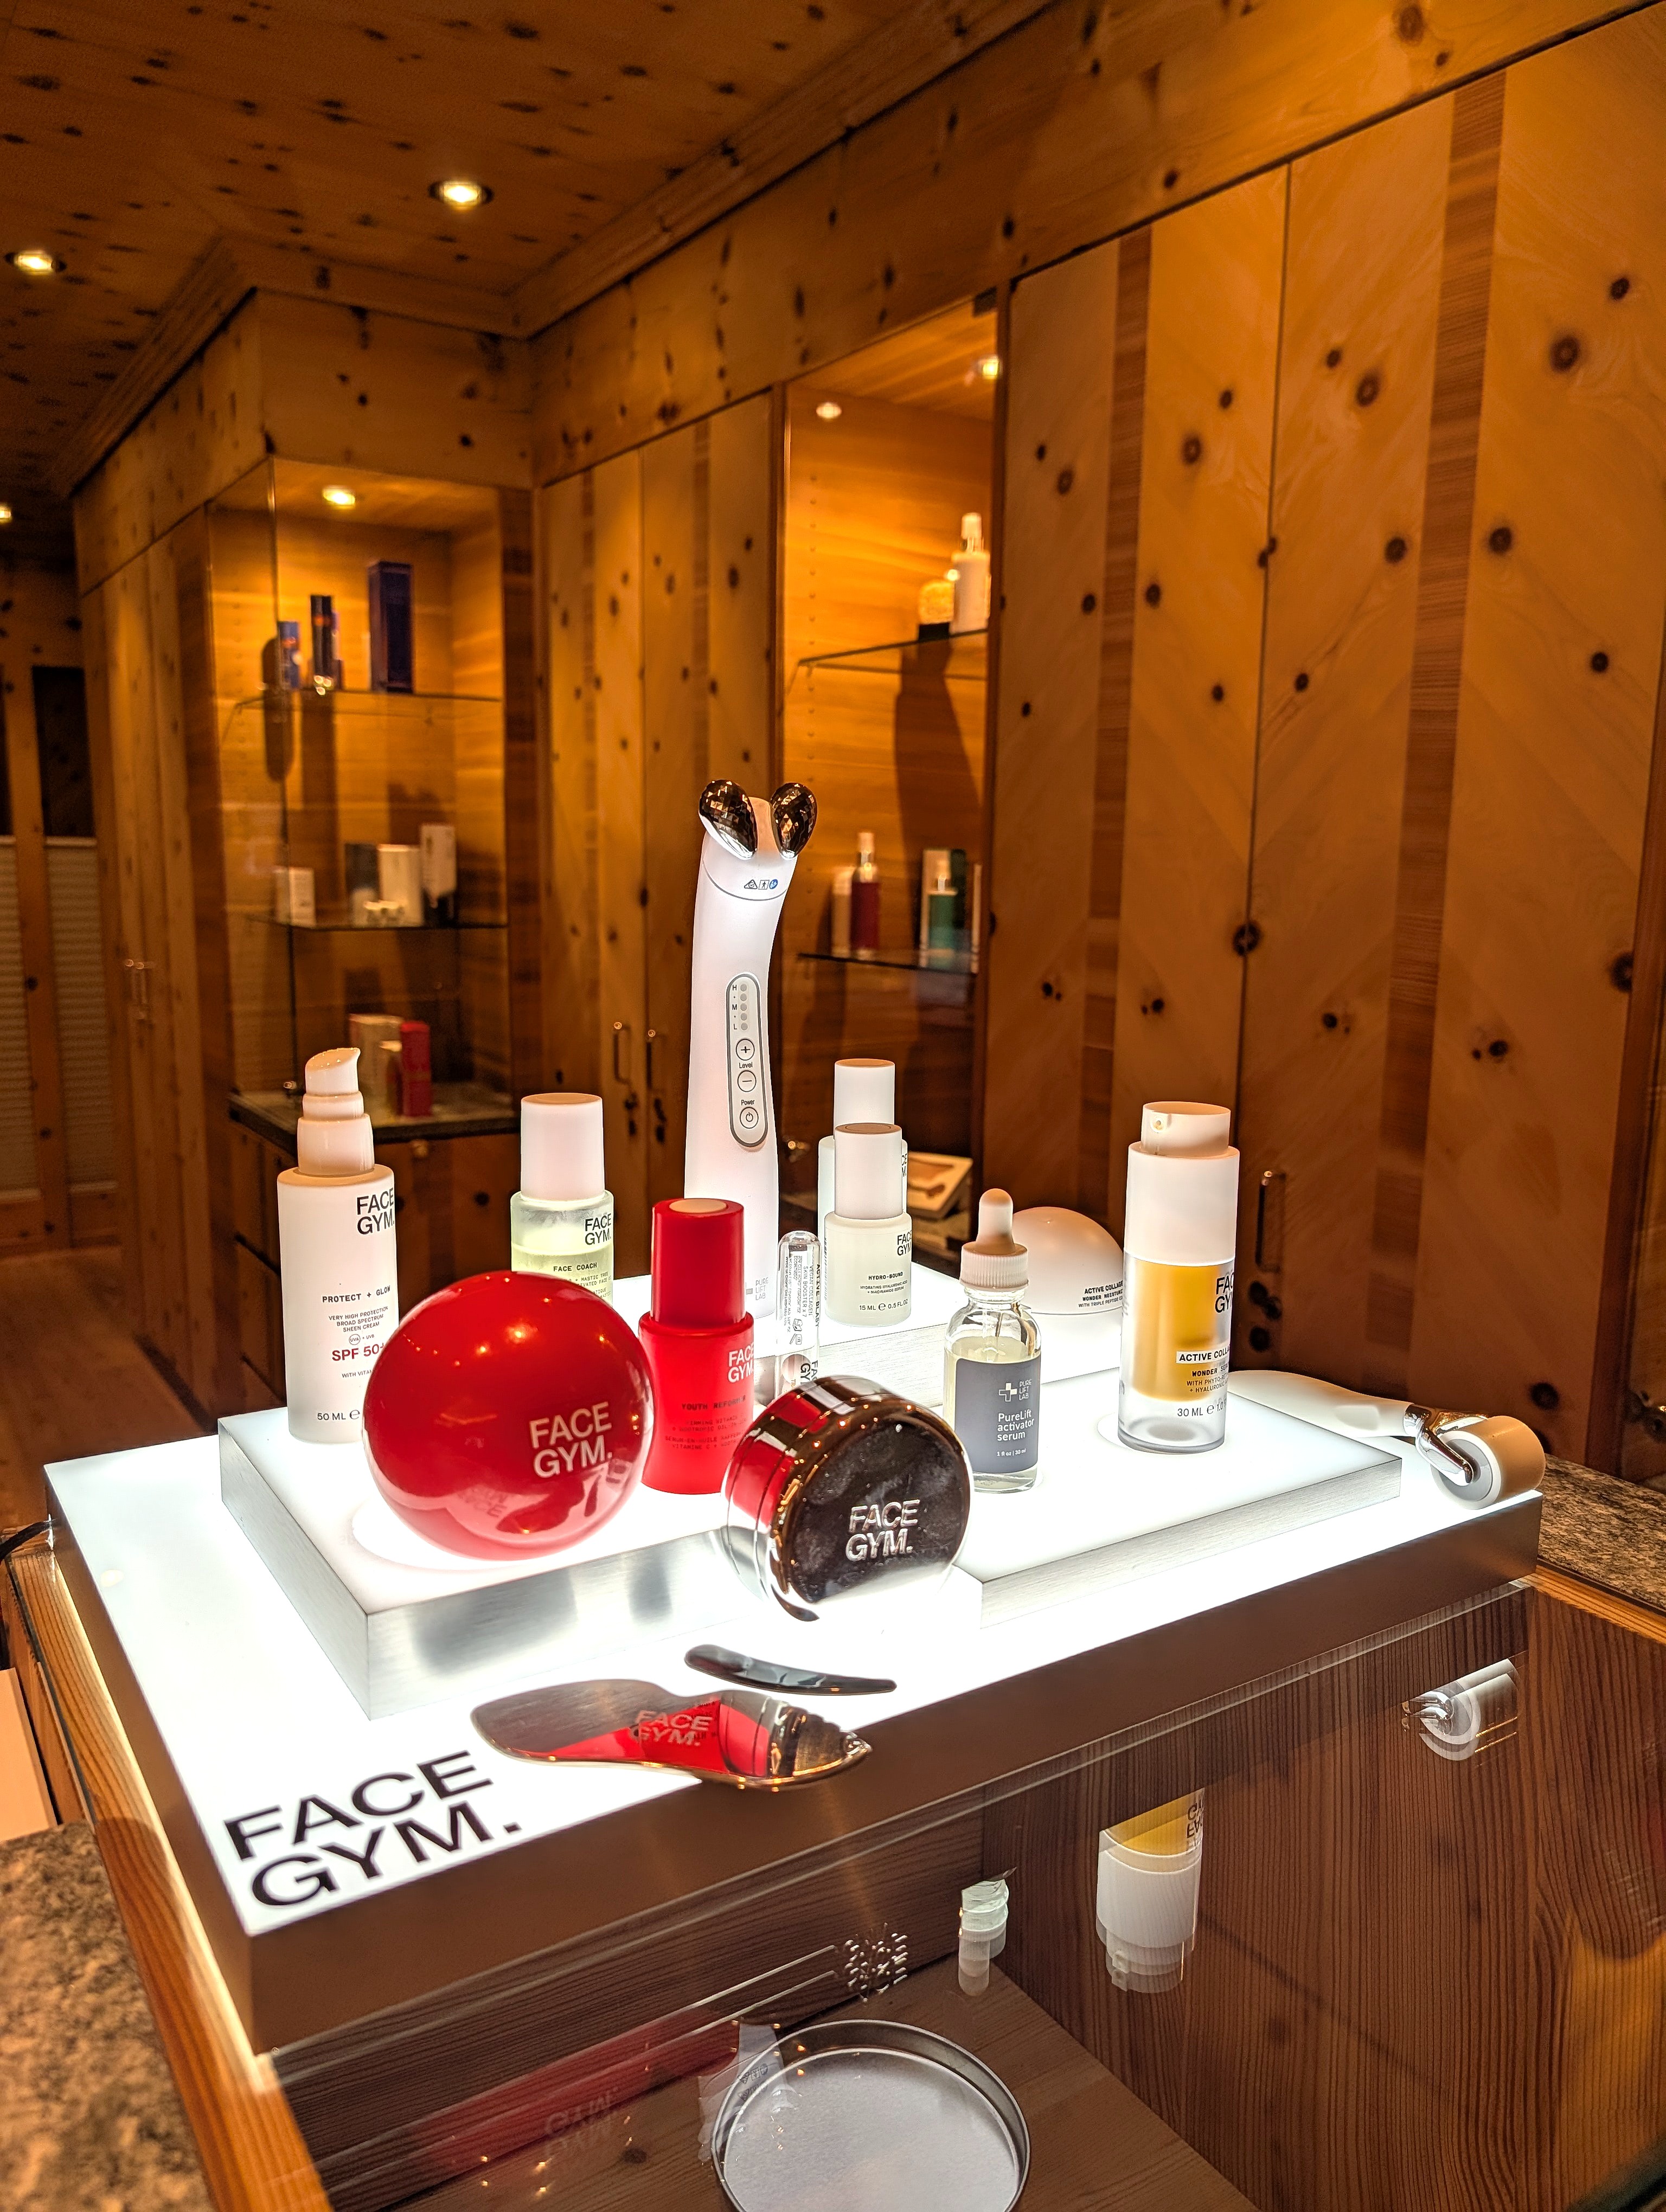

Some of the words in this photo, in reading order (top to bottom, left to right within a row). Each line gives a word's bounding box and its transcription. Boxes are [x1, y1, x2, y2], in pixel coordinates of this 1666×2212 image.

[357, 1187, 394, 1215] FACE
[357, 1208, 395, 1235] GYM.
[585, 1213, 612, 1232] FACE
[585, 1228, 612, 1245] GYM.
[576, 1262, 597, 1271] COACH
[755, 1277, 768, 1287] PURE
[868, 1271, 903, 1280] HYDRO-BOUND
[322, 1293, 362, 1303] PROTECT
[376, 1285, 391, 1296] GLOW
[1215, 1293, 1233, 1314] GY
[360, 1306, 388, 1317] PROTECTION
[357, 1314, 384, 1324] SPECTRUM
[362, 1321, 380, 1329] CREAM
[332, 1348, 359, 1361] SPF
[1179, 1352, 1212, 1361] ACTIVE
[800, 1363, 811, 1385] GY
[1192, 1368, 1218, 1377] WONDER
[1019, 1379, 1031, 1387] PURE
[1195, 1381, 1225, 1393] HYALURONIC
[1019, 1386, 1029, 1394] LIFT
[317, 1412, 330, 1420] 50
[998, 1409, 1031, 1422] PureLift
[1177, 1409, 1189, 1417] 30
[1191, 1407, 1203, 1417] ML
[529, 1401, 612, 1449] FACE
[997, 1418, 1034, 1432] activator
[997, 1431, 1025, 1442] serum
[534, 1435, 613, 1478] GYM.
[849, 1499, 920, 1533] FACE
[845, 1528, 913, 1562] GYM.
[635, 1709, 713, 1732] FACE
[630, 1724, 701, 1747] GYM.
[223, 1749, 494, 1863] FACE
[251, 1801, 522, 1908] GYM.
